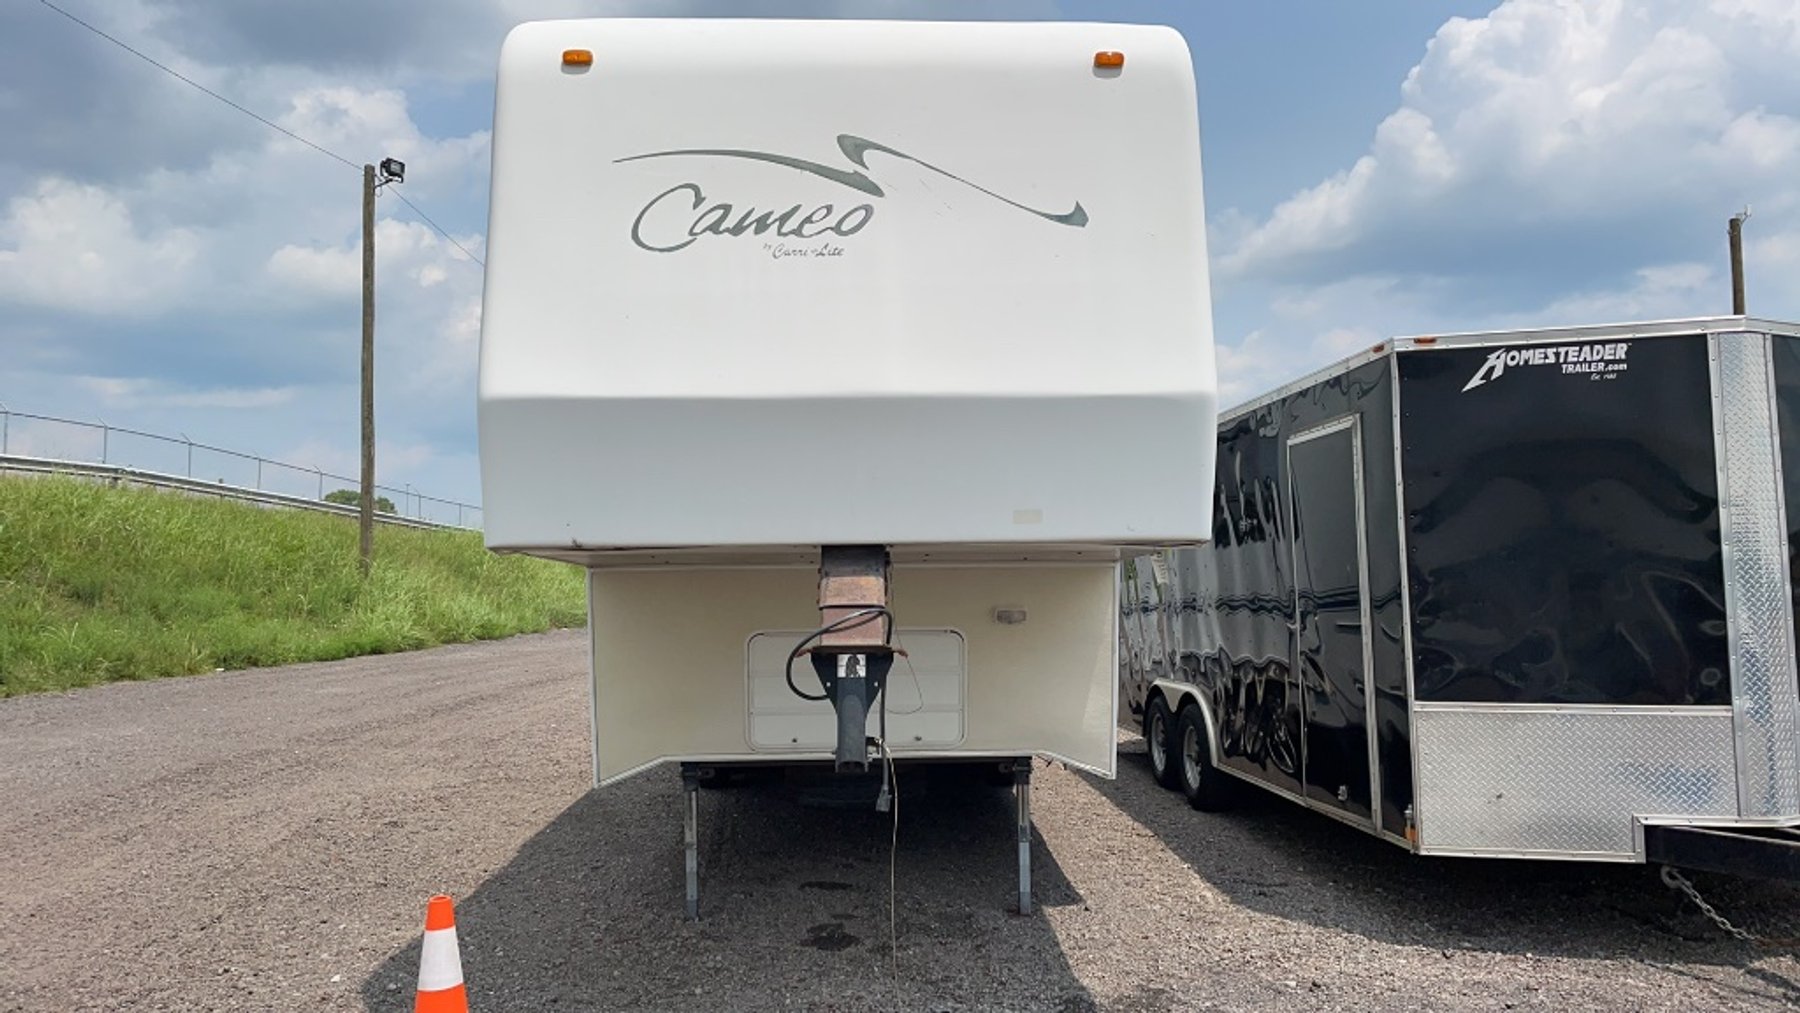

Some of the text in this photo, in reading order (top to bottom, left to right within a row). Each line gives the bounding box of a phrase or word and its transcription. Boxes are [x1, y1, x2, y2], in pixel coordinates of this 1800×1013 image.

[631, 183, 874, 252] Cameo
[1461, 343, 1628, 392] HOMESTEADER
[1561, 362, 1627, 374] TRAILER.com
